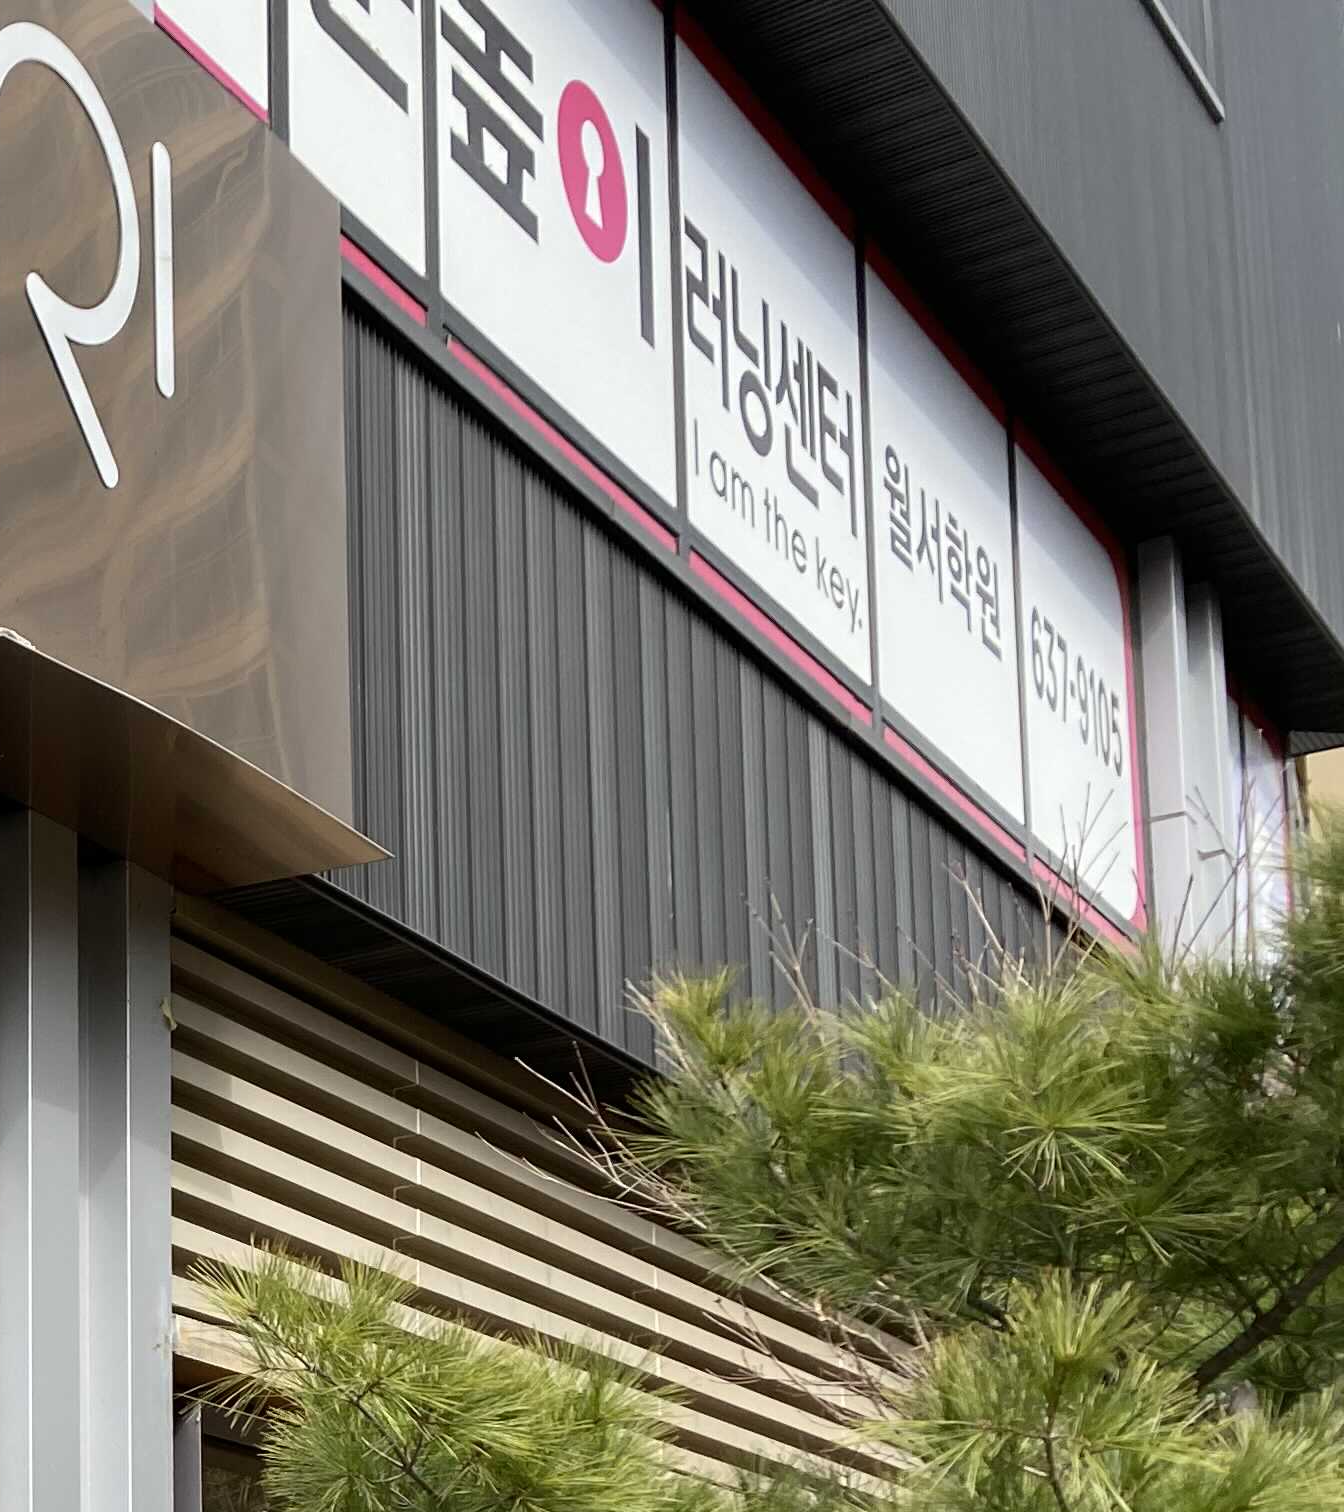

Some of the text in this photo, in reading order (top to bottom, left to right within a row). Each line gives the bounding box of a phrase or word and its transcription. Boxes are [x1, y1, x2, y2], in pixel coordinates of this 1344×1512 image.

[685, 215, 858, 538] 러닝센터
[710, 450, 755, 529] am
[763, 487, 807, 573] the
[884, 444, 1003, 661] 월서학원
[1031, 605, 1123, 776] 637-9105
